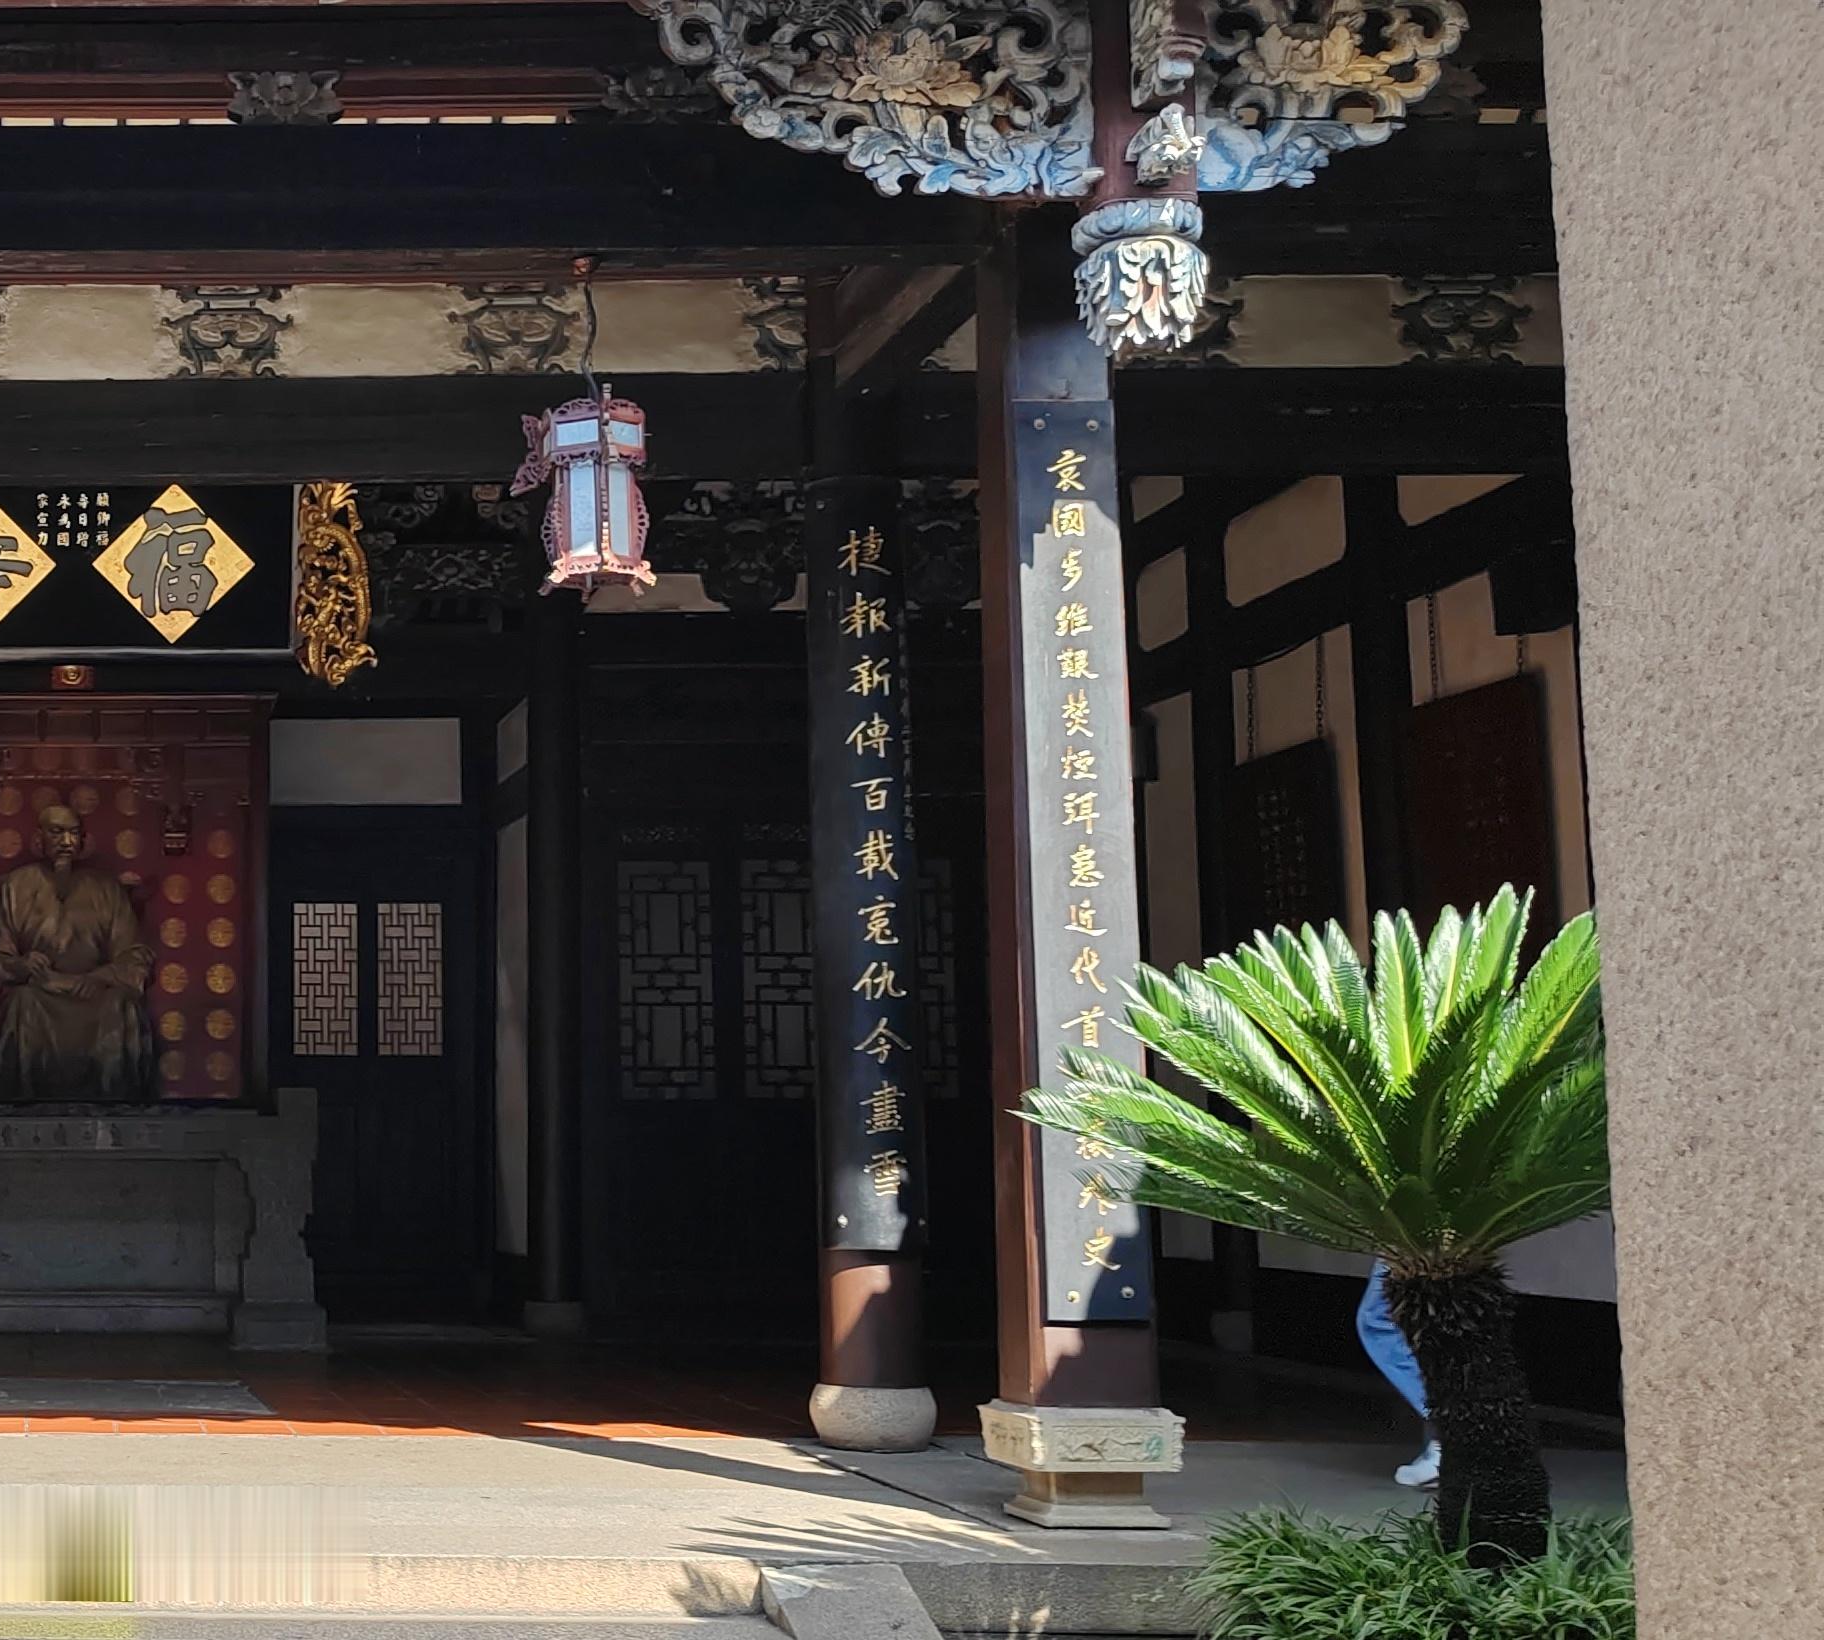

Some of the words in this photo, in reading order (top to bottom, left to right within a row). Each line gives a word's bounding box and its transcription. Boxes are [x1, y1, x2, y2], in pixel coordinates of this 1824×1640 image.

[36, 492, 49, 546] 家宣力
[124, 507, 219, 619] 福
